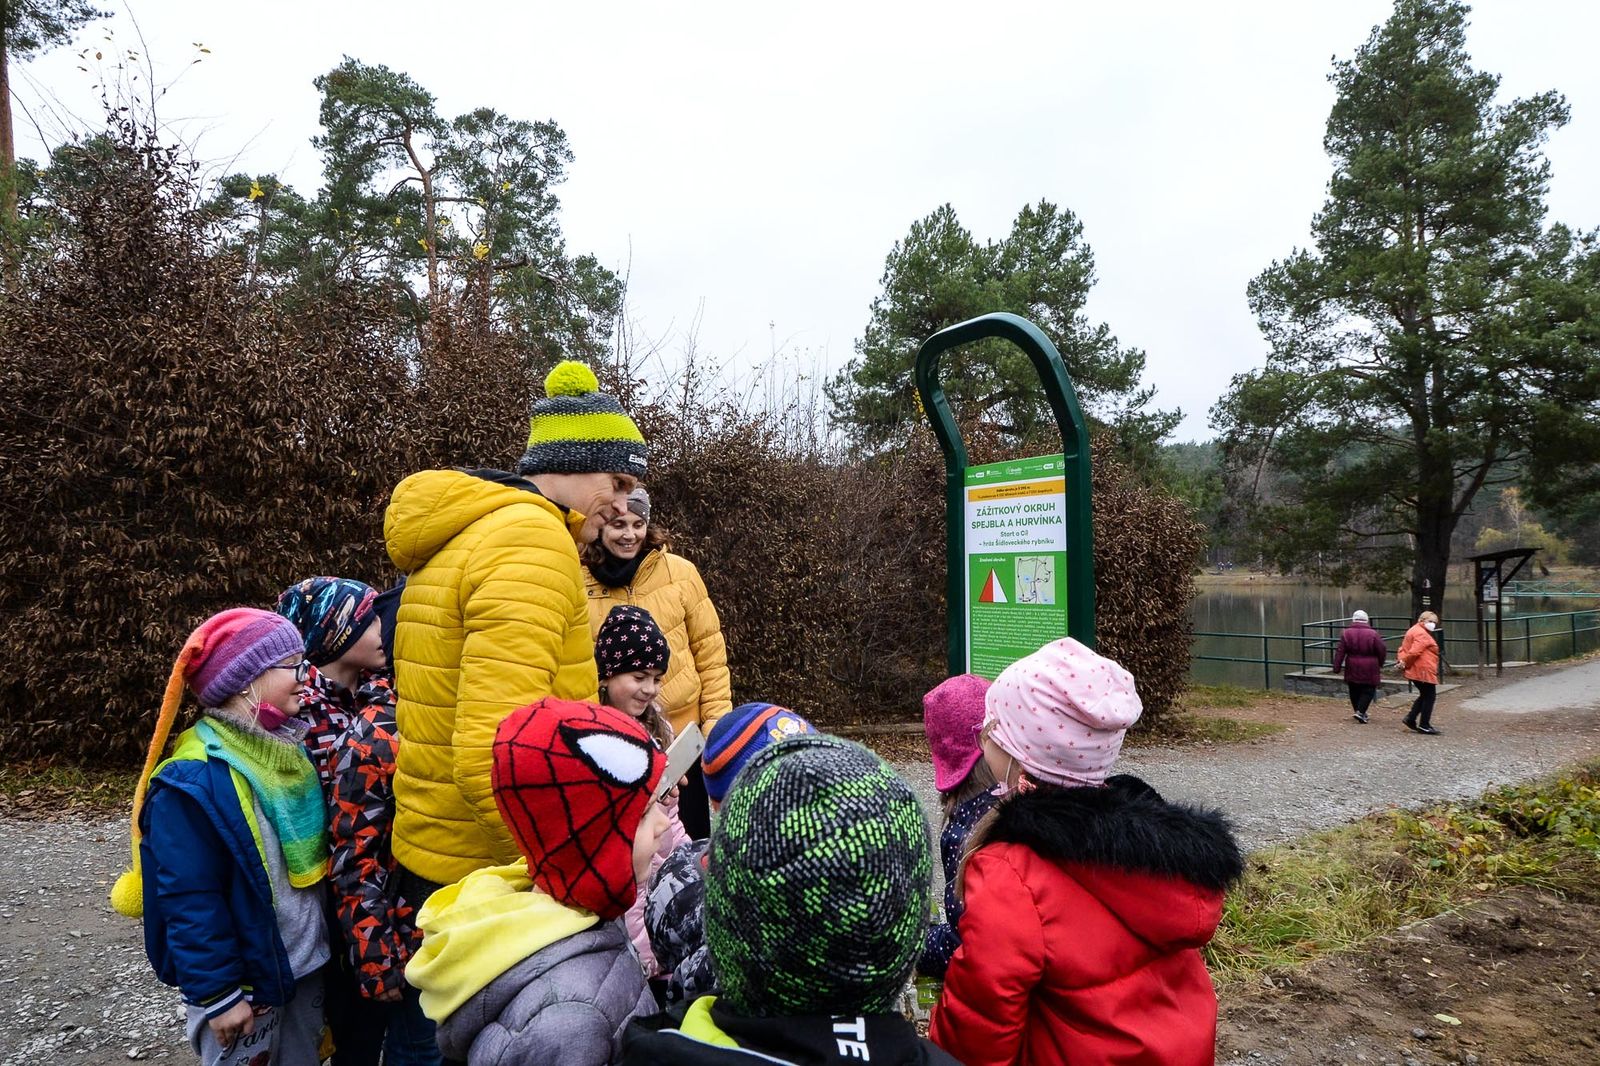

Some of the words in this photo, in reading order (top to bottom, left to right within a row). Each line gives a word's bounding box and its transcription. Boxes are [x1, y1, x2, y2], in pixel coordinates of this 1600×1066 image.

[976, 503, 1022, 517] ZÁŽITKOVÝ
[1023, 502, 1056, 513] OKRUH
[971, 519, 1006, 530] SPEJBLA
[1007, 518, 1014, 527] A
[1015, 514, 1063, 527] HURVÍNKA
[1000, 530, 1015, 538] Start
[831, 1014, 870, 1062] TE
